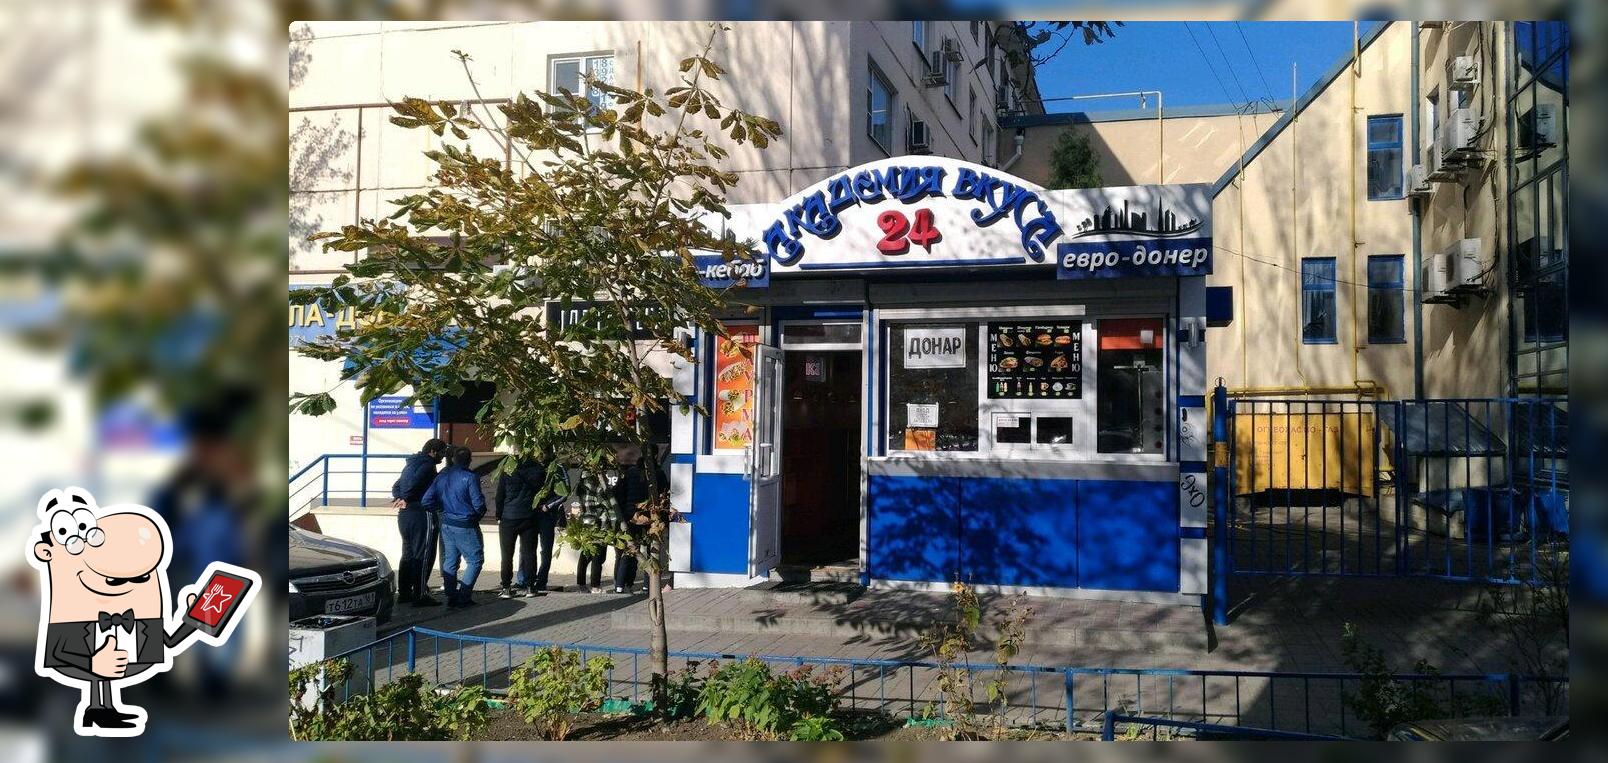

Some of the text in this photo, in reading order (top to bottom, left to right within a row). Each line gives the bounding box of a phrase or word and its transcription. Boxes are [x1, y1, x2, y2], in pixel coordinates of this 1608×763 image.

[763, 166, 1064, 266] АКАДЕМИЯ ВКУСА
[877, 208, 942, 254] 24
[1062, 245, 1208, 271] евро-донер
[908, 337, 962, 360] ДОНАР
